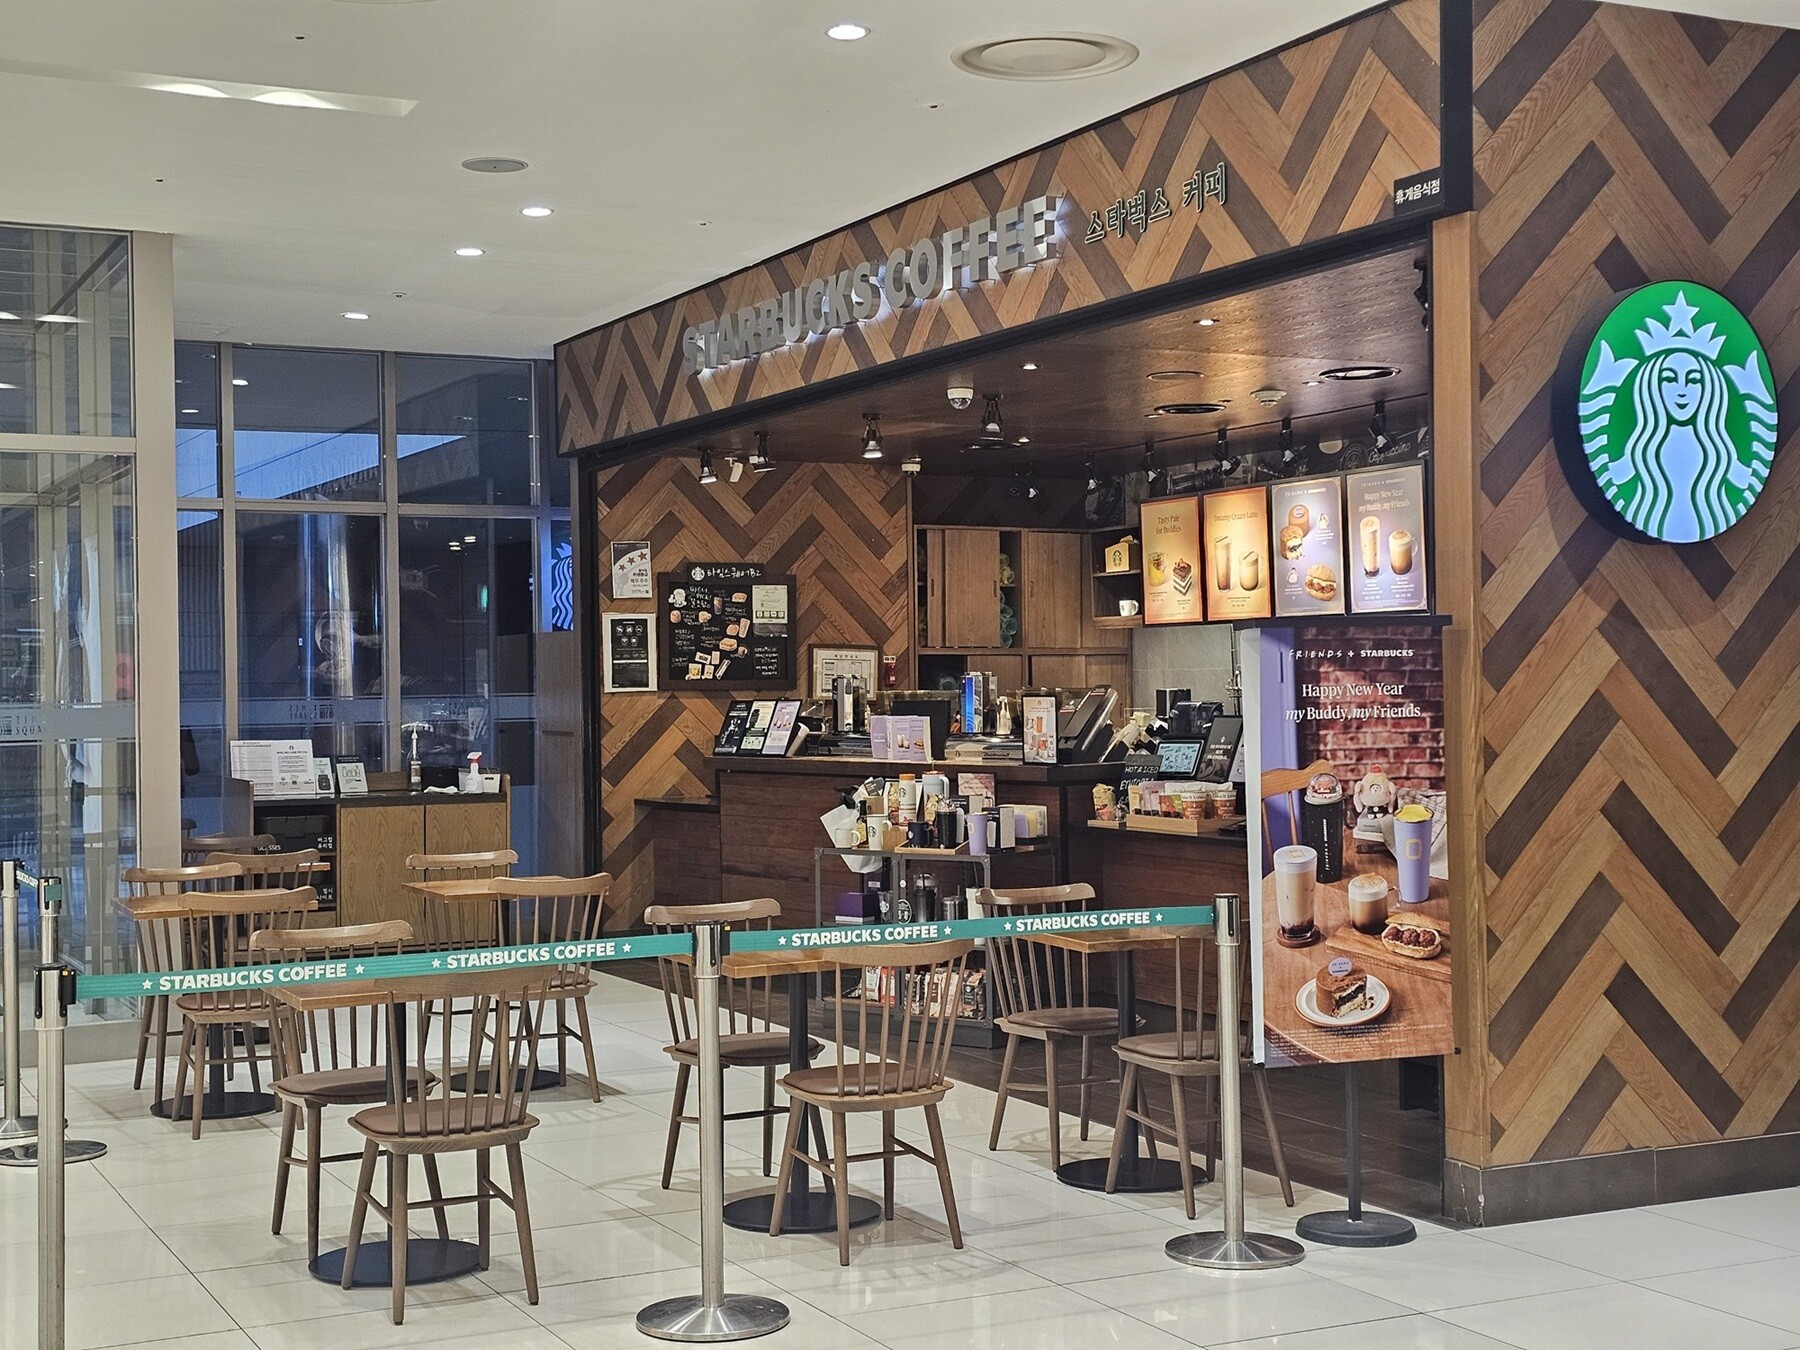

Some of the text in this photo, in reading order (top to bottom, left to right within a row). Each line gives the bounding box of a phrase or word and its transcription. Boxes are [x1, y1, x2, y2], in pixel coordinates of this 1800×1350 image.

[1085, 161, 1226, 244] 스타벅스 커피
[1395, 178, 1440, 205] 휴게음식점
[683, 195, 1062, 376] STARBUCKS COFFEE
[1360, 649, 1415, 657] STARBUCKS
[1302, 682, 1405, 699] Happy New Year
[1285, 703, 1421, 723] my Buddy, my Friends
[1016, 912, 1151, 932] STARBUCKS COFFEE
[791, 925, 938, 947] STARBUCKS COFFEE
[447, 942, 616, 969] STARBUCKS COFFEE
[159, 963, 347, 991] STARBUCKS COFFEE
